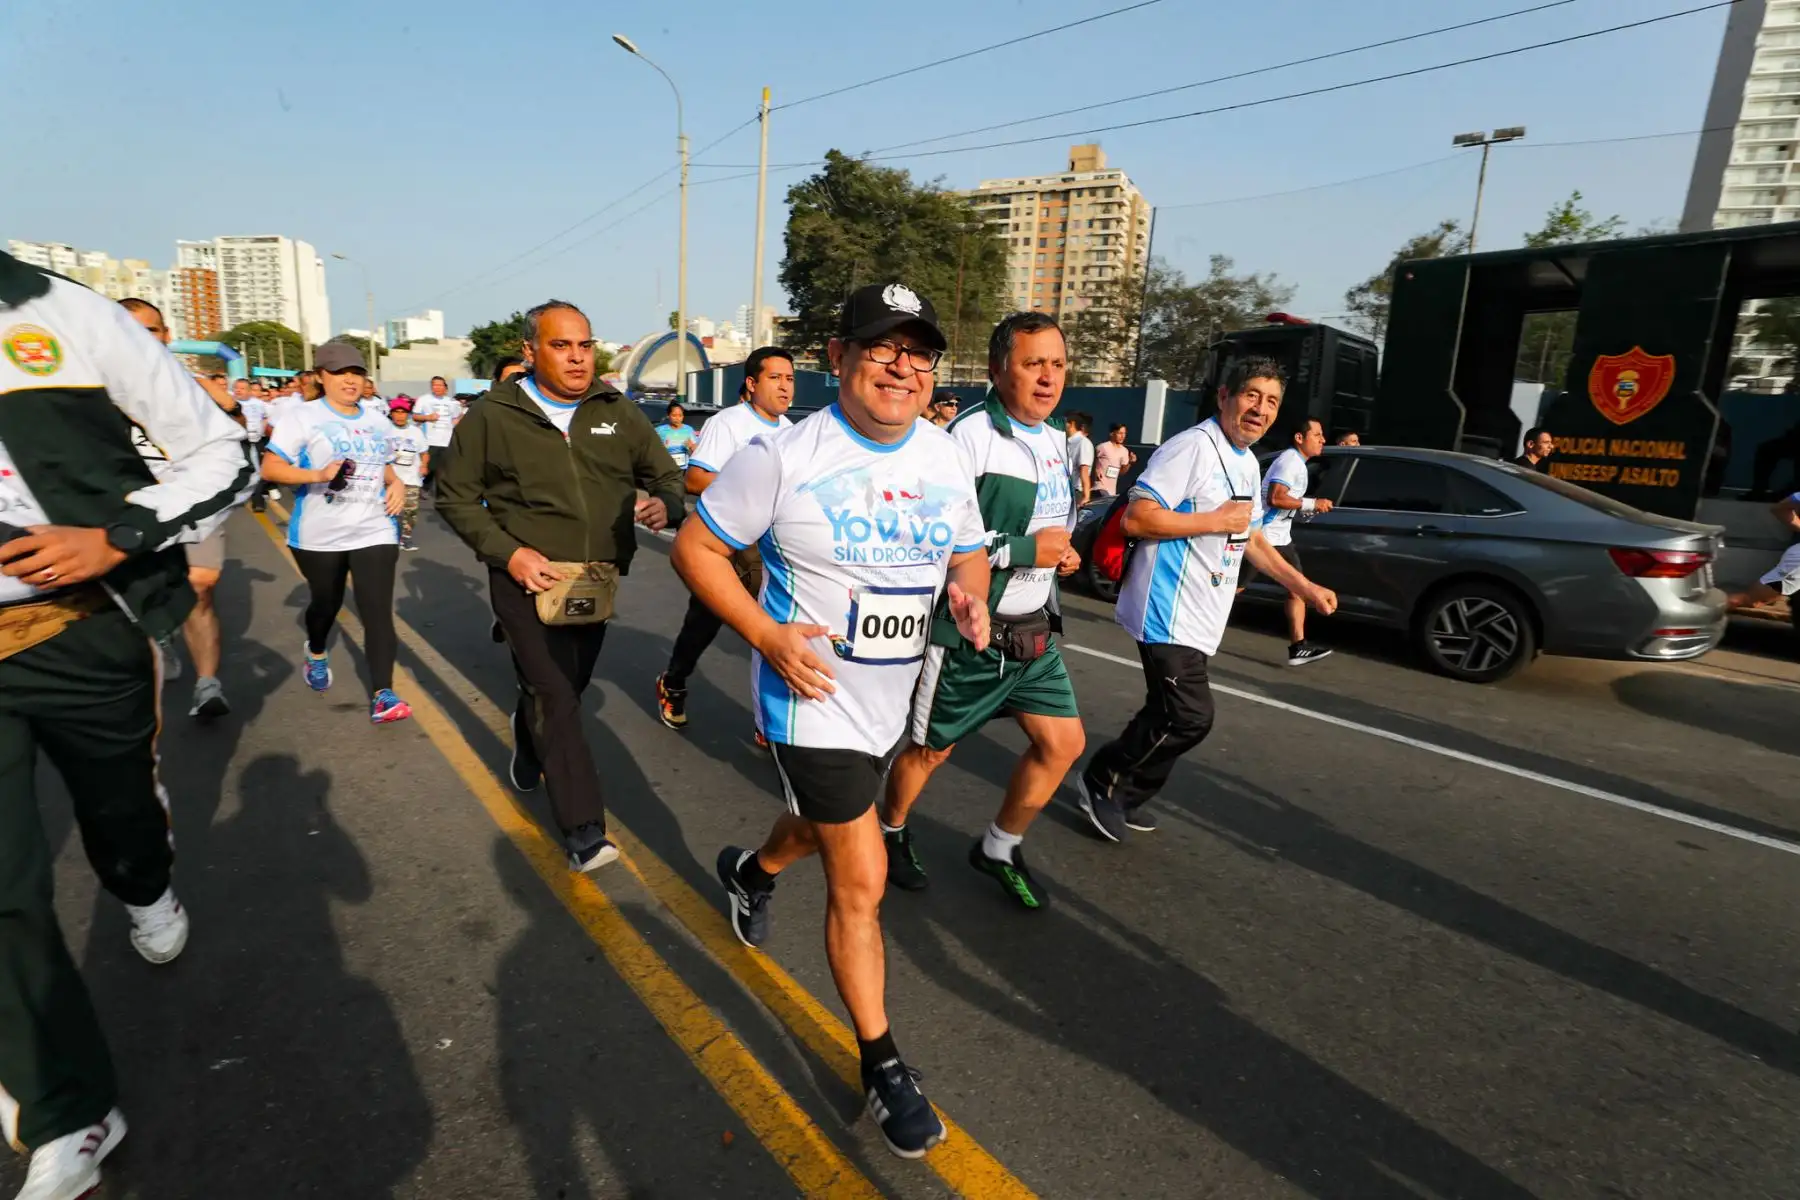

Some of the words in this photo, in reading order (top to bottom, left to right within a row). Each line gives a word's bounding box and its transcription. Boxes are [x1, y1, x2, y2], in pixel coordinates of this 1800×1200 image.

[1297, 336, 1314, 382] IVECO
[1551, 437, 1606, 456] POLICIA
[1609, 439, 1686, 460] NACIONAL
[1619, 466, 1680, 487] ASALTO
[875, 508, 953, 547] VVO
[833, 545, 868, 563] SIN
[872, 546, 945, 563] DROGAS
[862, 613, 926, 639] 0001
